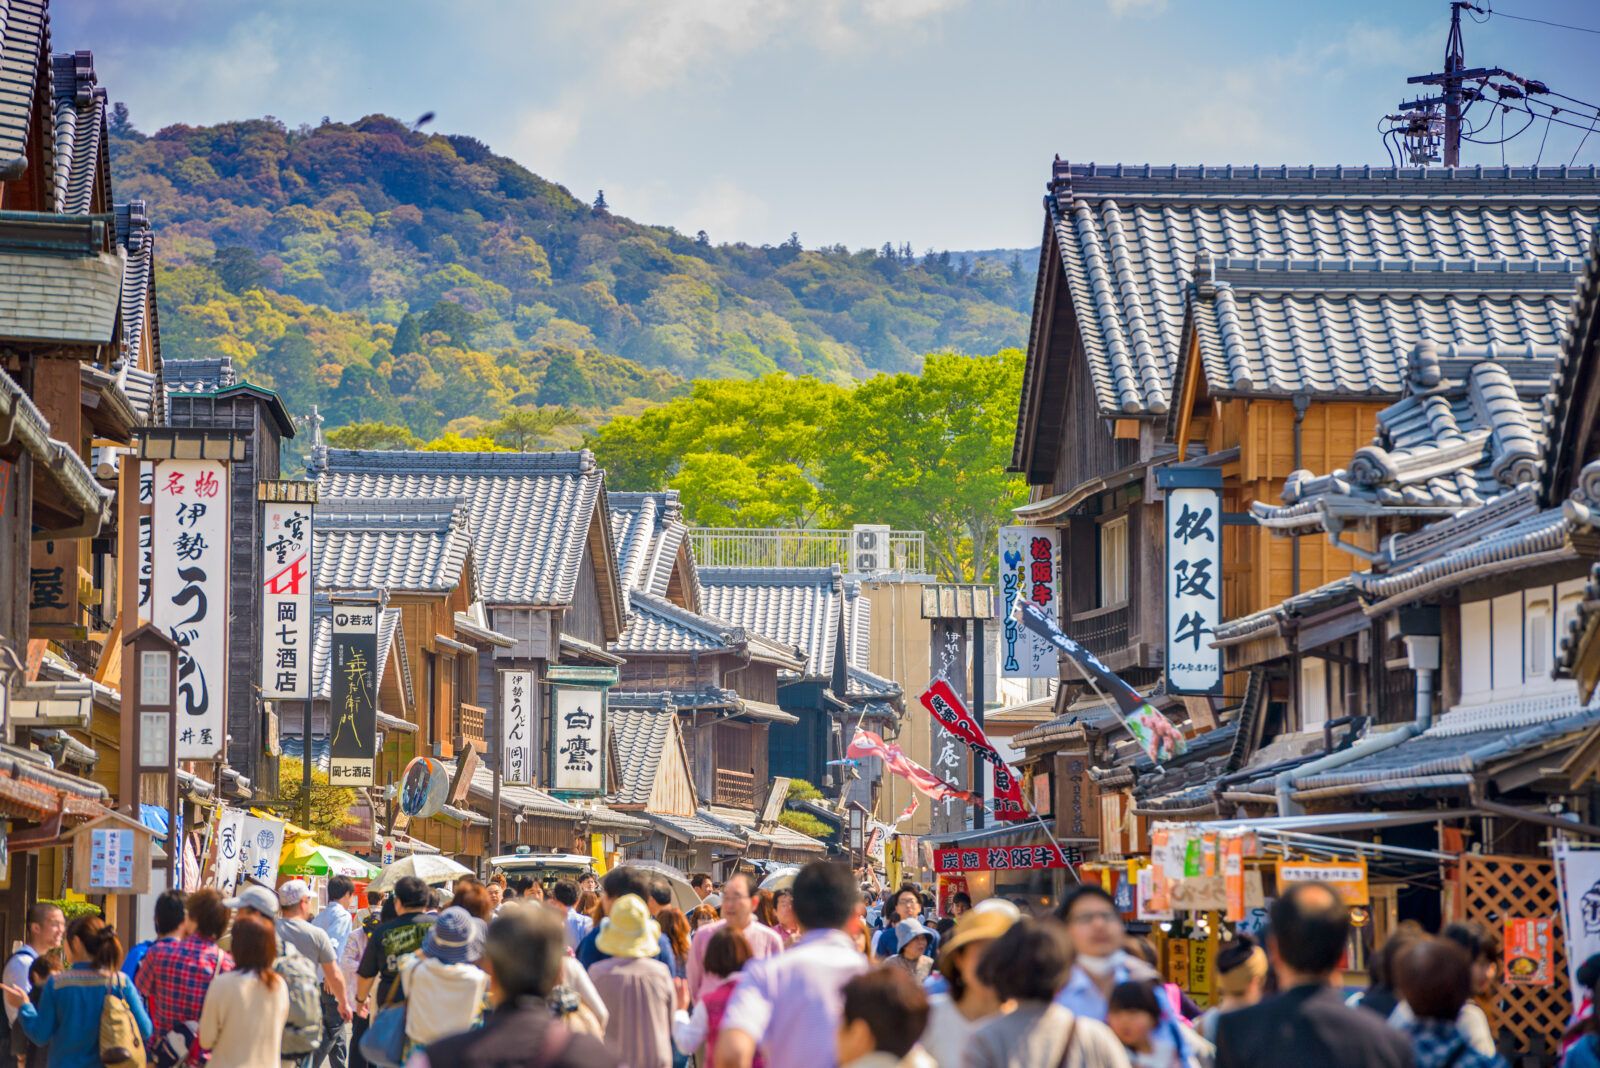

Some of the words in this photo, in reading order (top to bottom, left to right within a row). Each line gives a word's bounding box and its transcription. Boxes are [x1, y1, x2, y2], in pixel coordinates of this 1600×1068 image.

[161, 470, 219, 498] 名物
[1030, 537, 1052, 606] 松阪牛
[1173, 503, 1216, 654] 松阪牛
[170, 502, 209, 716] 伊勢うどん
[275, 602, 298, 692] 岡七酒店
[509, 675, 526, 740] 伊勢うどん
[559, 705, 598, 773] 白鷹
[332, 765, 372, 778] 岡七酒店
[510, 746, 523, 782] 岡田屋
[942, 853, 980, 869] 炭焼
[987, 846, 1082, 869] 松阪牛串
